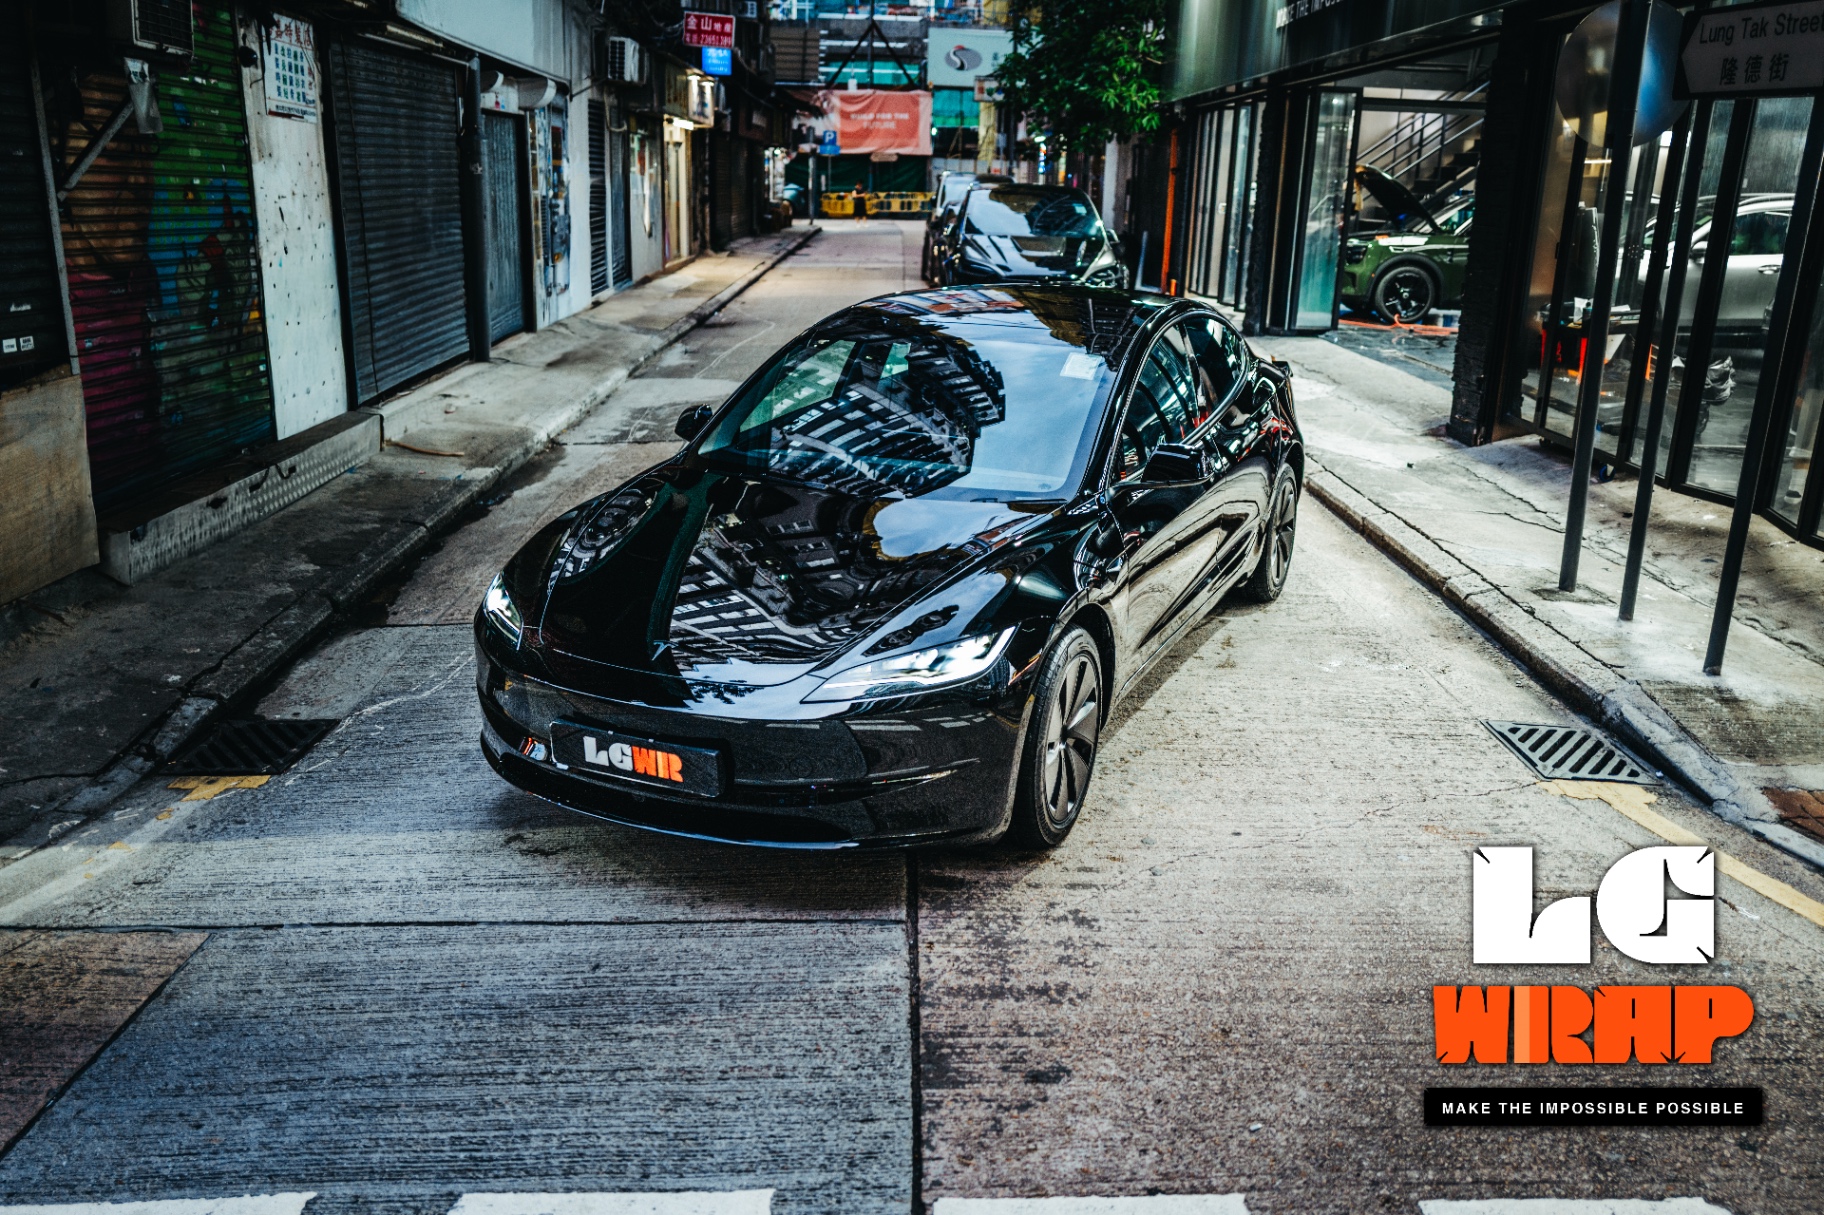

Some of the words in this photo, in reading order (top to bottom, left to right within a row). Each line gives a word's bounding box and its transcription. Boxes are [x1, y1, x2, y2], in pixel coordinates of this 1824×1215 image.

[1699, 23, 1735, 46] Lung
[1741, 17, 1769, 39] Tak
[1719, 52, 1789, 85] 隆德街
[825, 131, 835, 143] P
